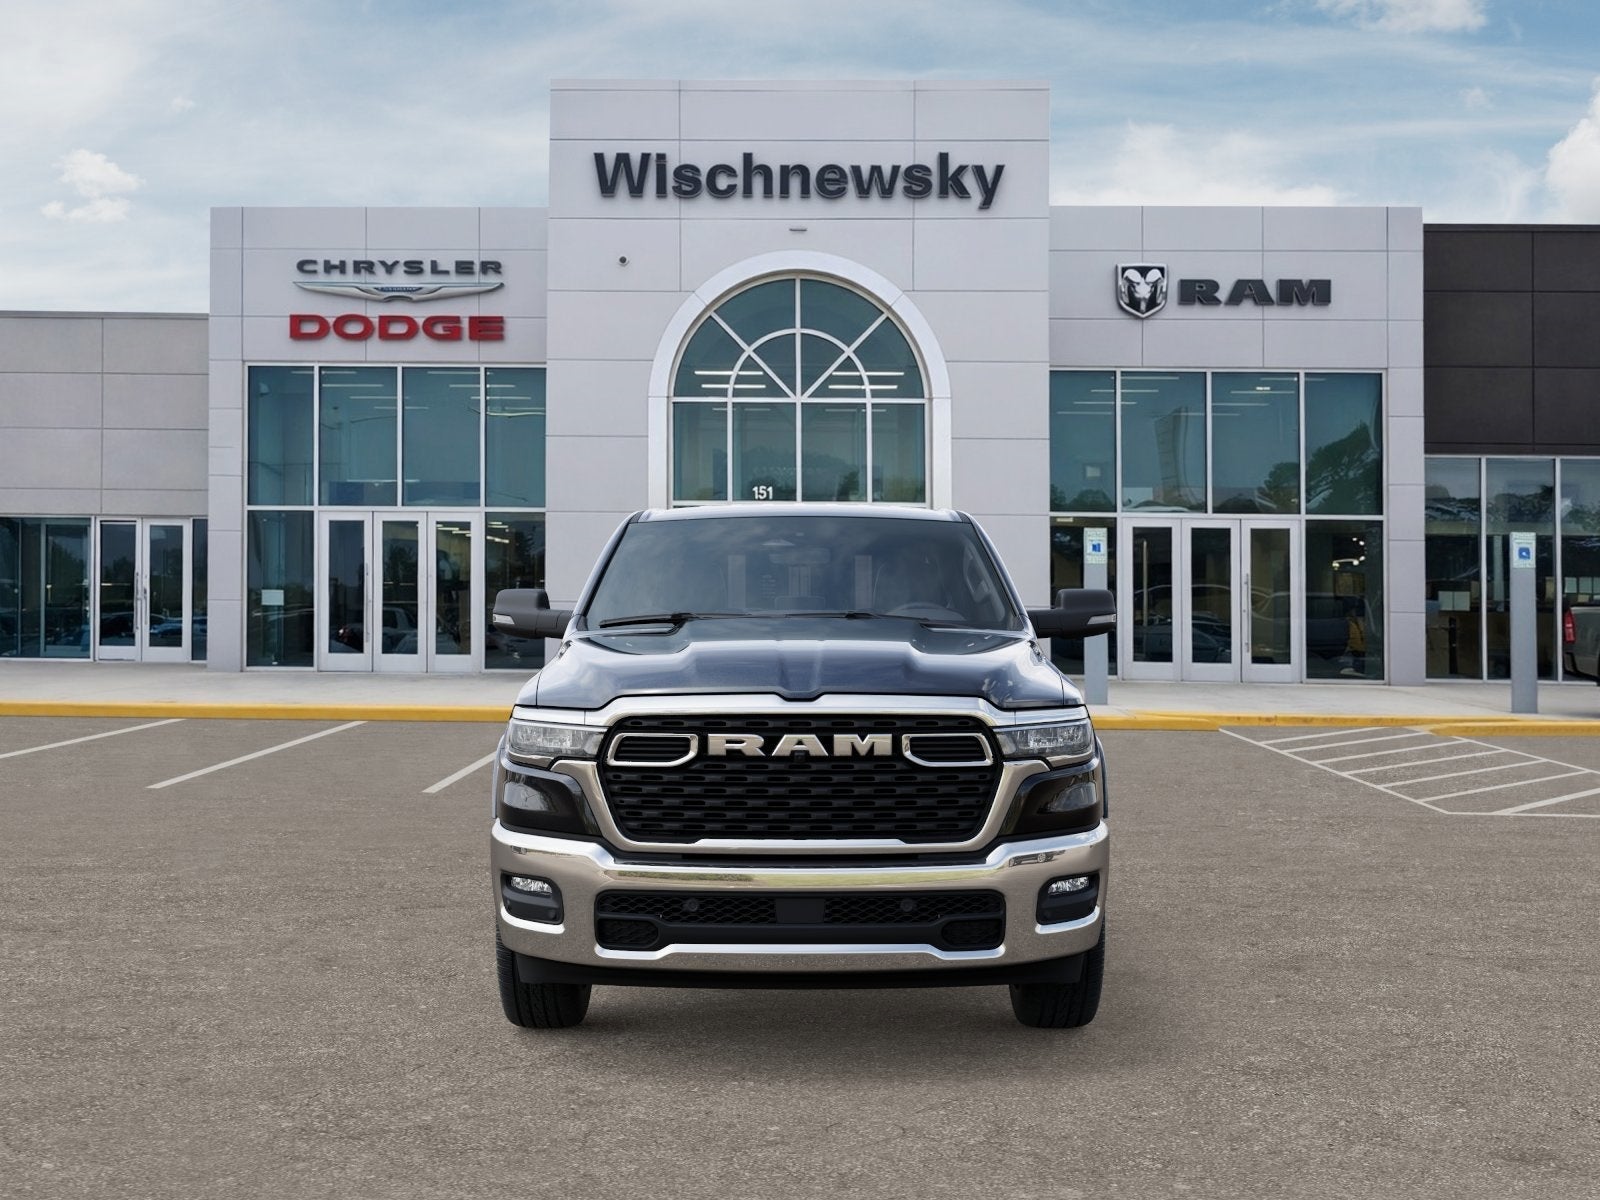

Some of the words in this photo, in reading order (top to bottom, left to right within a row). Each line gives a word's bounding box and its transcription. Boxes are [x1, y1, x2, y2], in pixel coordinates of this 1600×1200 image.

[593, 152, 1005, 210] Wischnewsky
[296, 259, 503, 275] CHRYSLER
[1177, 279, 1332, 306] RAM
[289, 314, 505, 341] DODGE
[752, 485, 773, 500] 151
[707, 733, 893, 757] RAM
